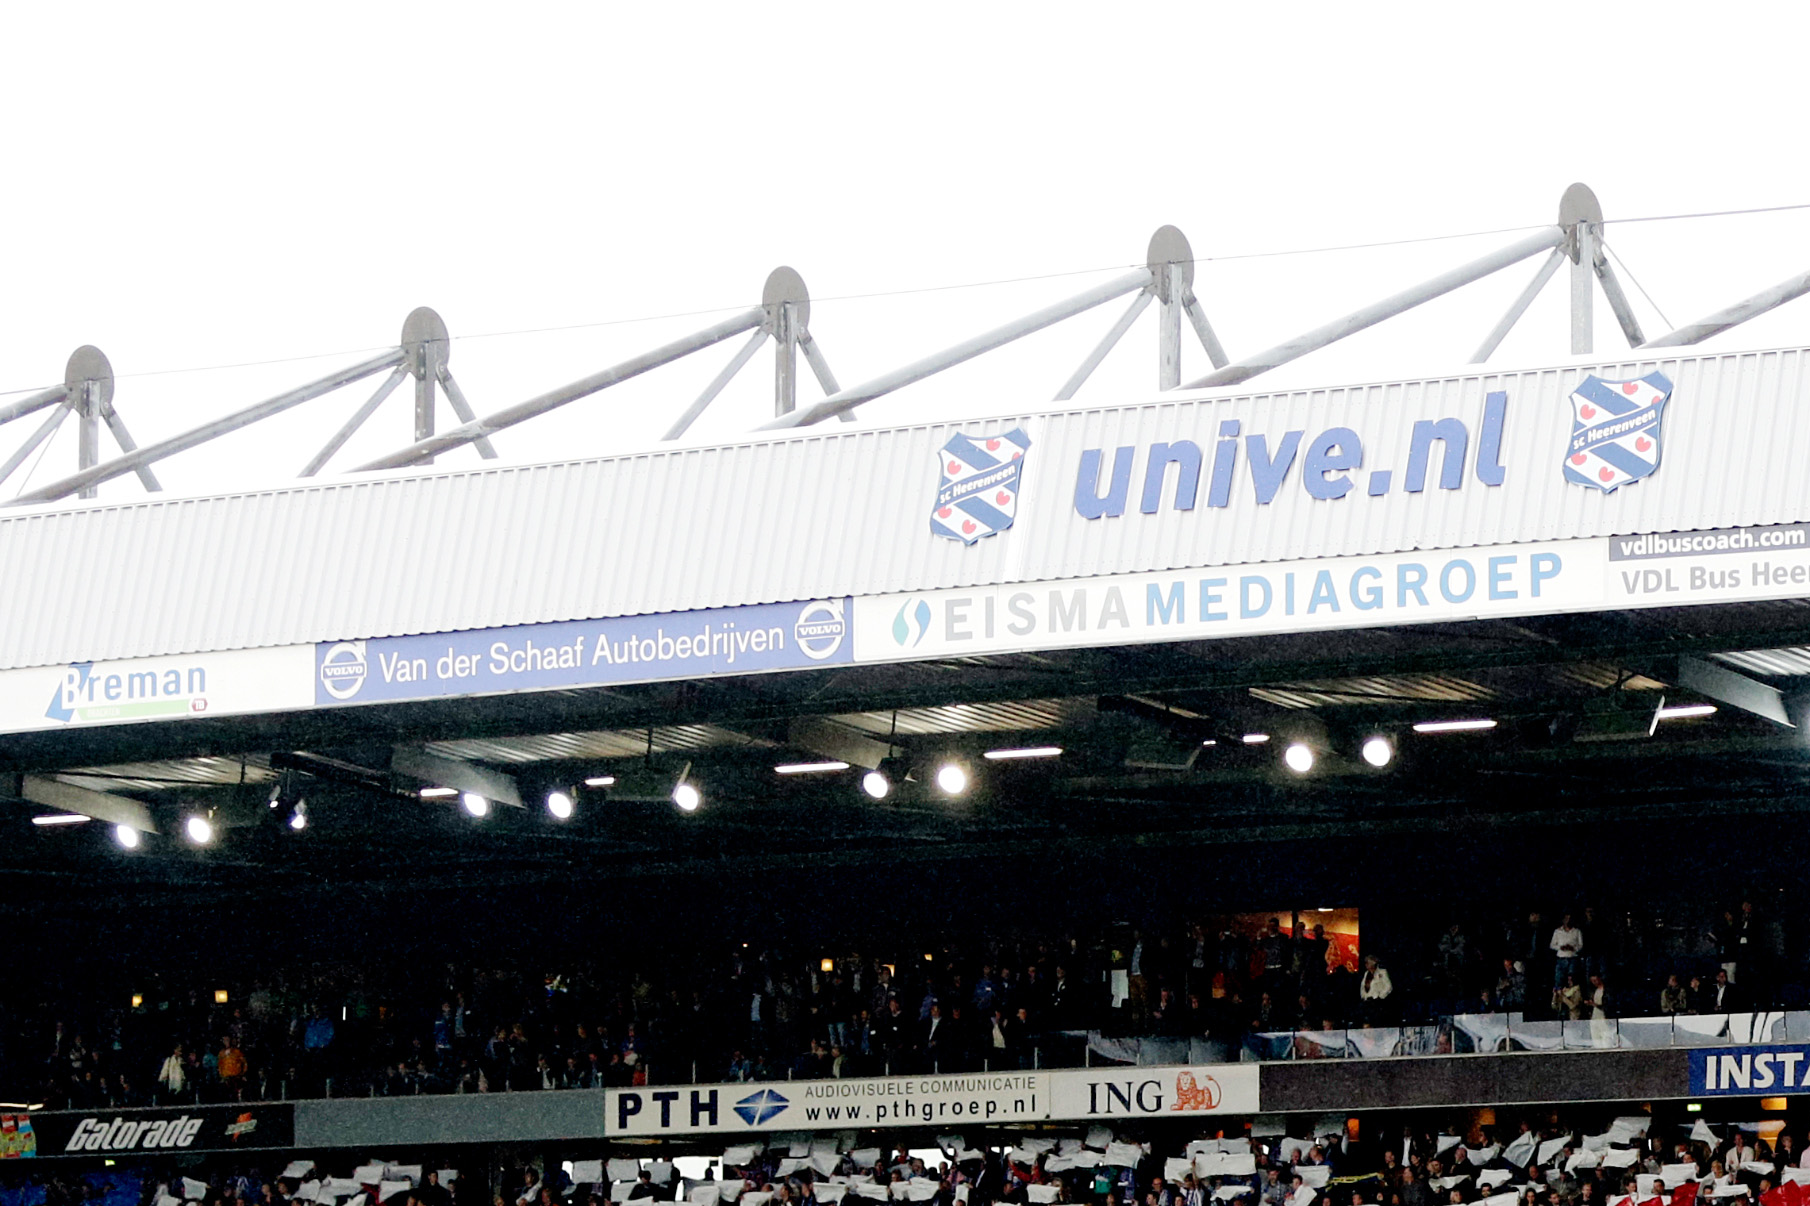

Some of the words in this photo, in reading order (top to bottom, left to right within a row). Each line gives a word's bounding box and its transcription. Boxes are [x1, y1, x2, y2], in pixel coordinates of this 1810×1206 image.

[1587, 409, 1657, 443] Heerenveen
[1074, 392, 1507, 520] unive.nl
[952, 464, 1017, 497] Heerenveen
[1621, 526, 1806, 556] vdlbuscoach.com
[1621, 567, 1681, 596] VDL
[1689, 561, 1742, 590] Bus
[943, 588, 1130, 644] EISMA
[1144, 552, 1563, 628] MEDIAGROEP
[797, 624, 842, 636] VOLVO
[324, 664, 364, 677] VOLVO
[378, 651, 427, 684] Van
[436, 647, 481, 680] der
[489, 635, 585, 676] Schaaf
[591, 622, 785, 666] Autobedrijven
[62, 664, 206, 710] Breman
[805, 1081, 915, 1098] AUDIOVISUELE
[920, 1077, 1036, 1094] COMMUNICATIE
[1087, 1080, 1163, 1115] ING
[617, 1090, 718, 1130] PTH
[805, 1094, 1036, 1122] www.pthgroep.nl
[65, 1115, 204, 1151] Gatorade
